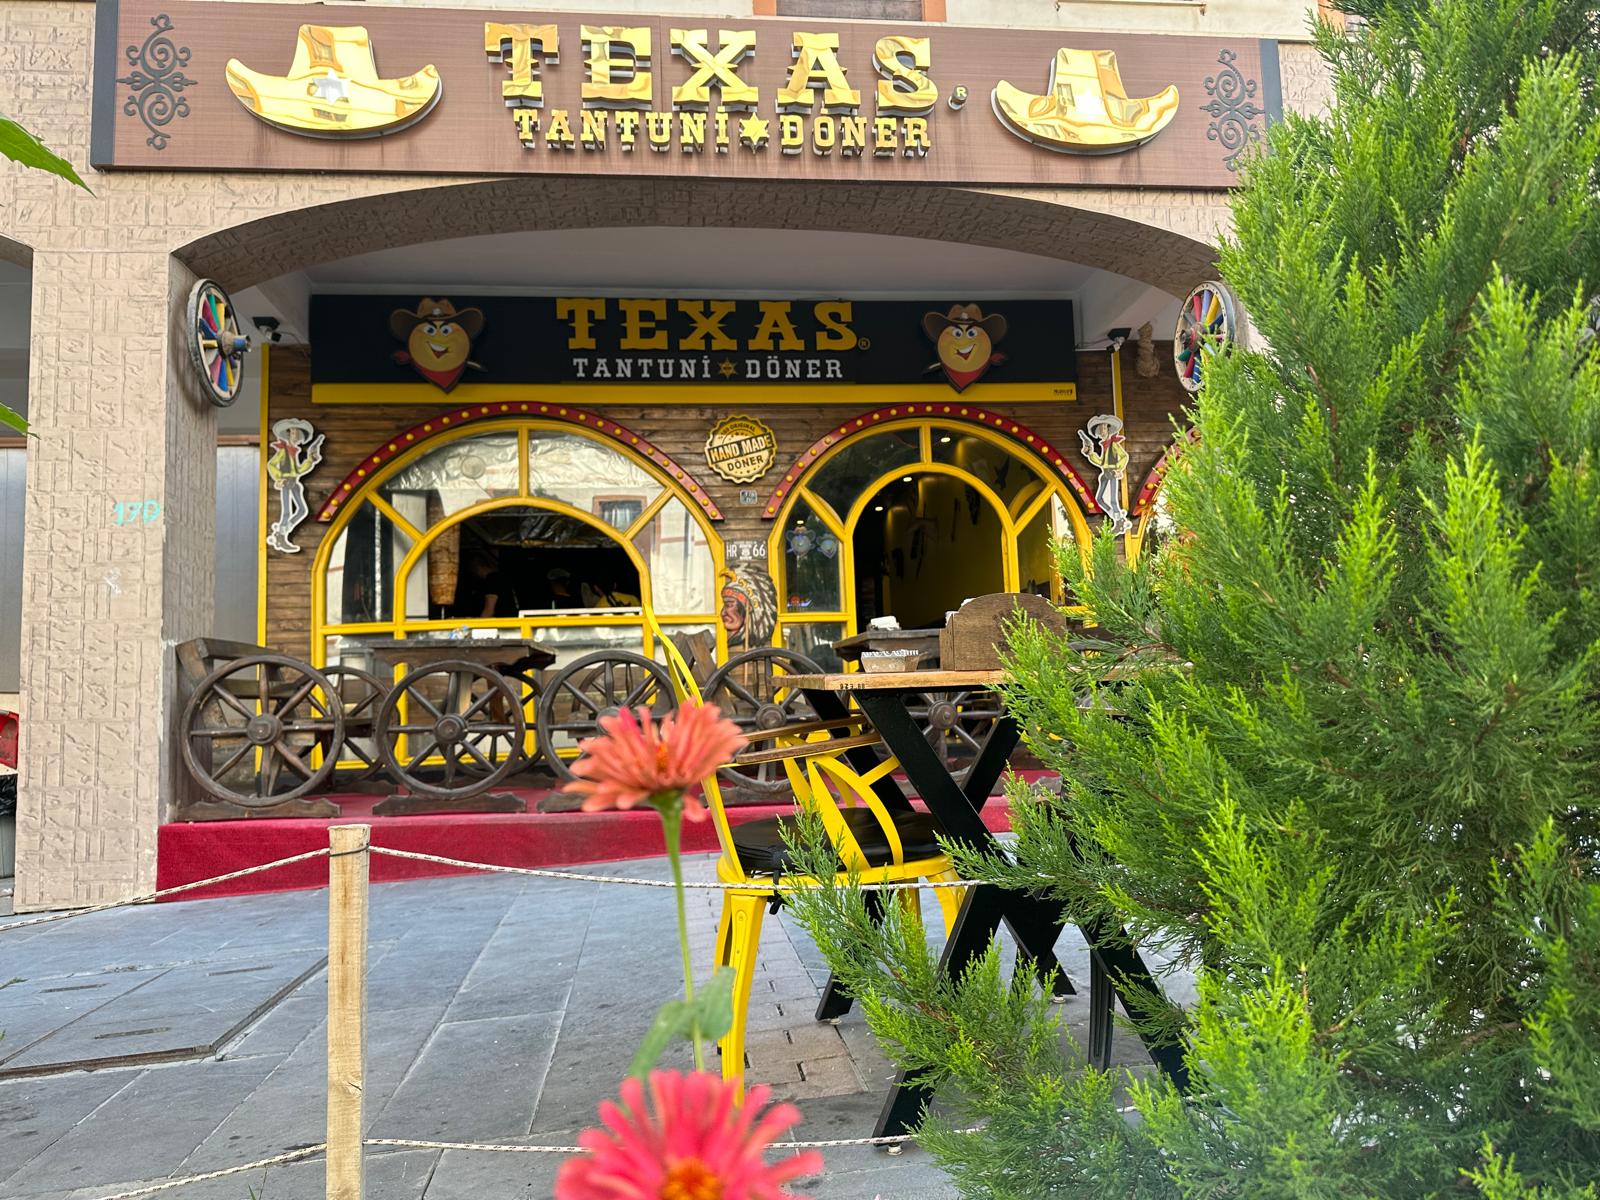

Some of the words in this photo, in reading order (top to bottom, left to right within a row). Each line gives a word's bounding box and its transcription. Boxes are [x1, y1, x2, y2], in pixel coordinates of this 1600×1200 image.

[484, 21, 938, 114] TEXAS
[556, 298, 857, 351] TEXAS
[573, 355, 711, 378] TANTUNİ
[745, 355, 843, 378] DÖNER
[710, 443, 740, 462] HAND
[741, 434, 772, 454] MADE
[726, 544, 738, 557] HR
[752, 544, 766, 557] 66
